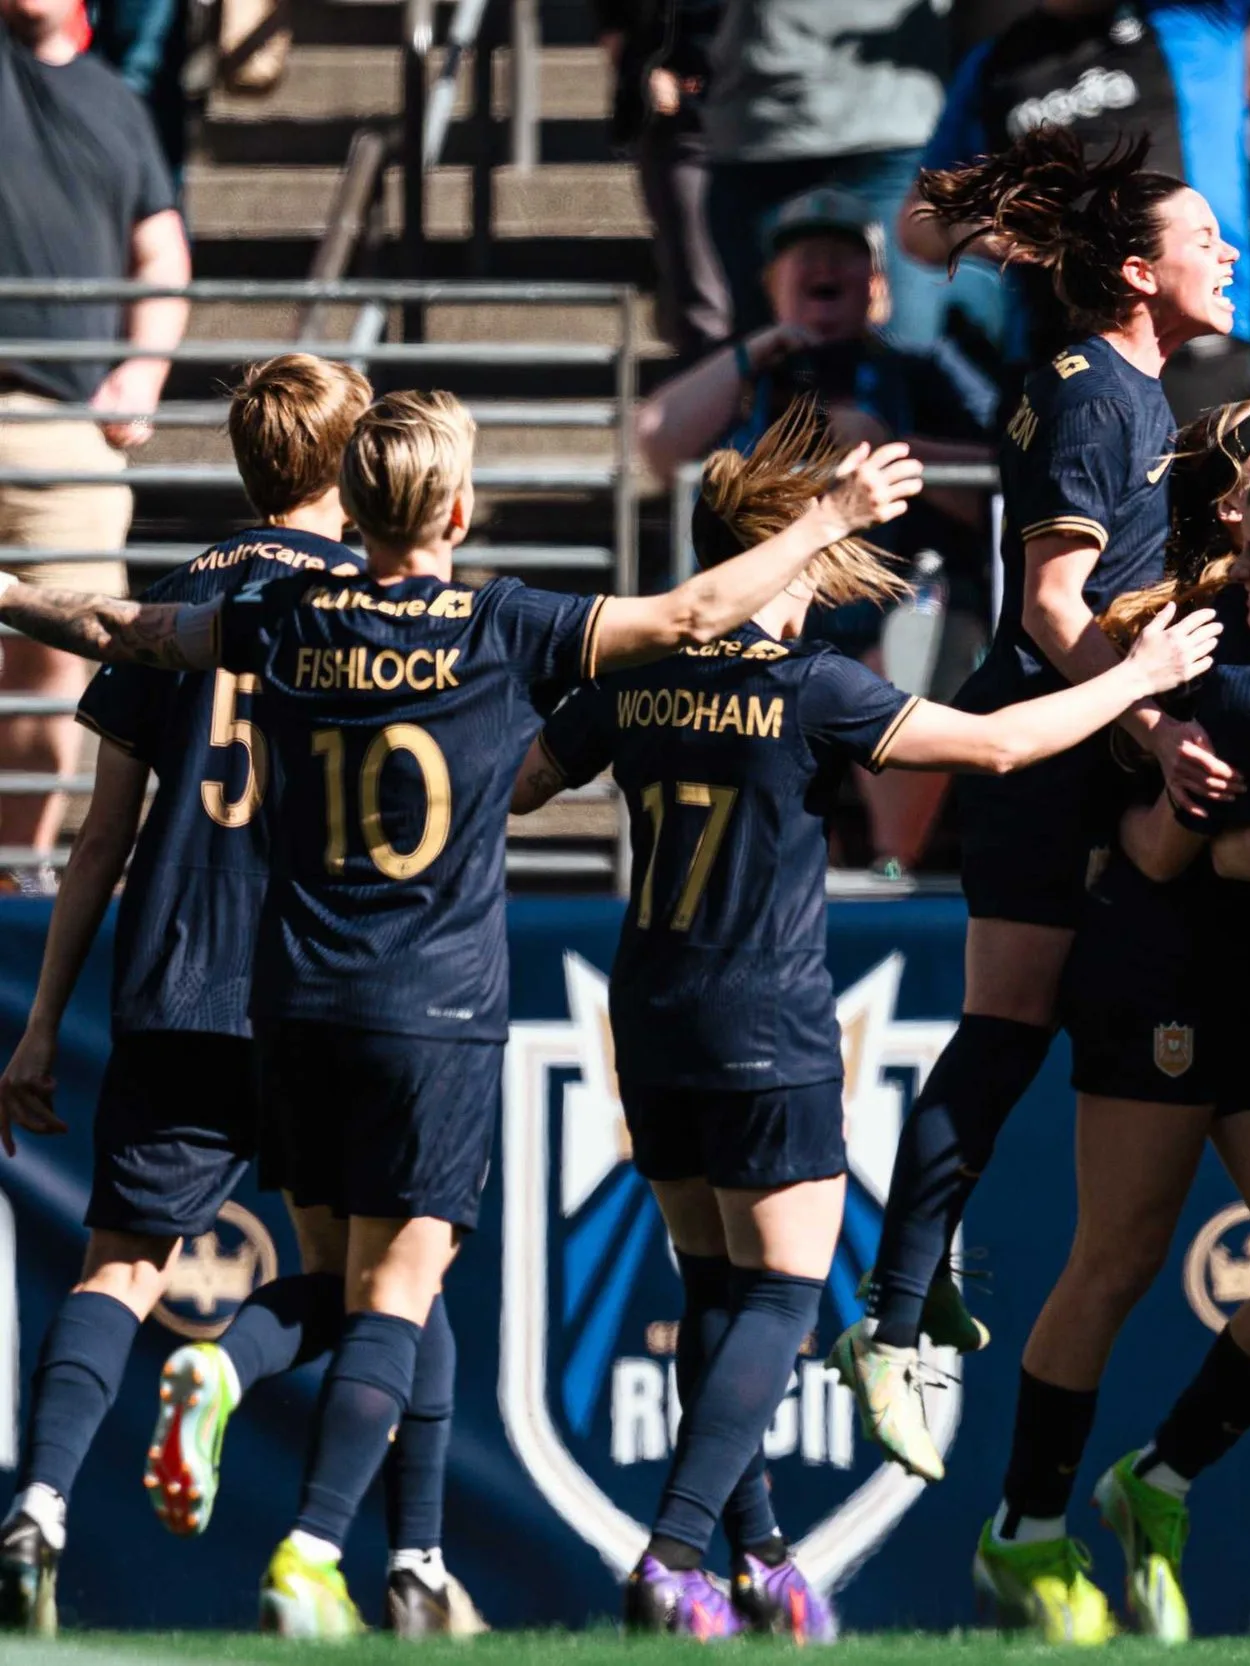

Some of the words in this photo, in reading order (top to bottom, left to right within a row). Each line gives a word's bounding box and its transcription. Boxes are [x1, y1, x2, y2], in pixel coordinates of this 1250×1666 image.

[190, 541, 325, 573] MultiCare
[295, 647, 461, 691] FISHLOCK
[616, 688, 784, 738] WOODHAM
[201, 667, 269, 828] 5
[311, 722, 451, 880] 10
[637, 780, 739, 930] 17
